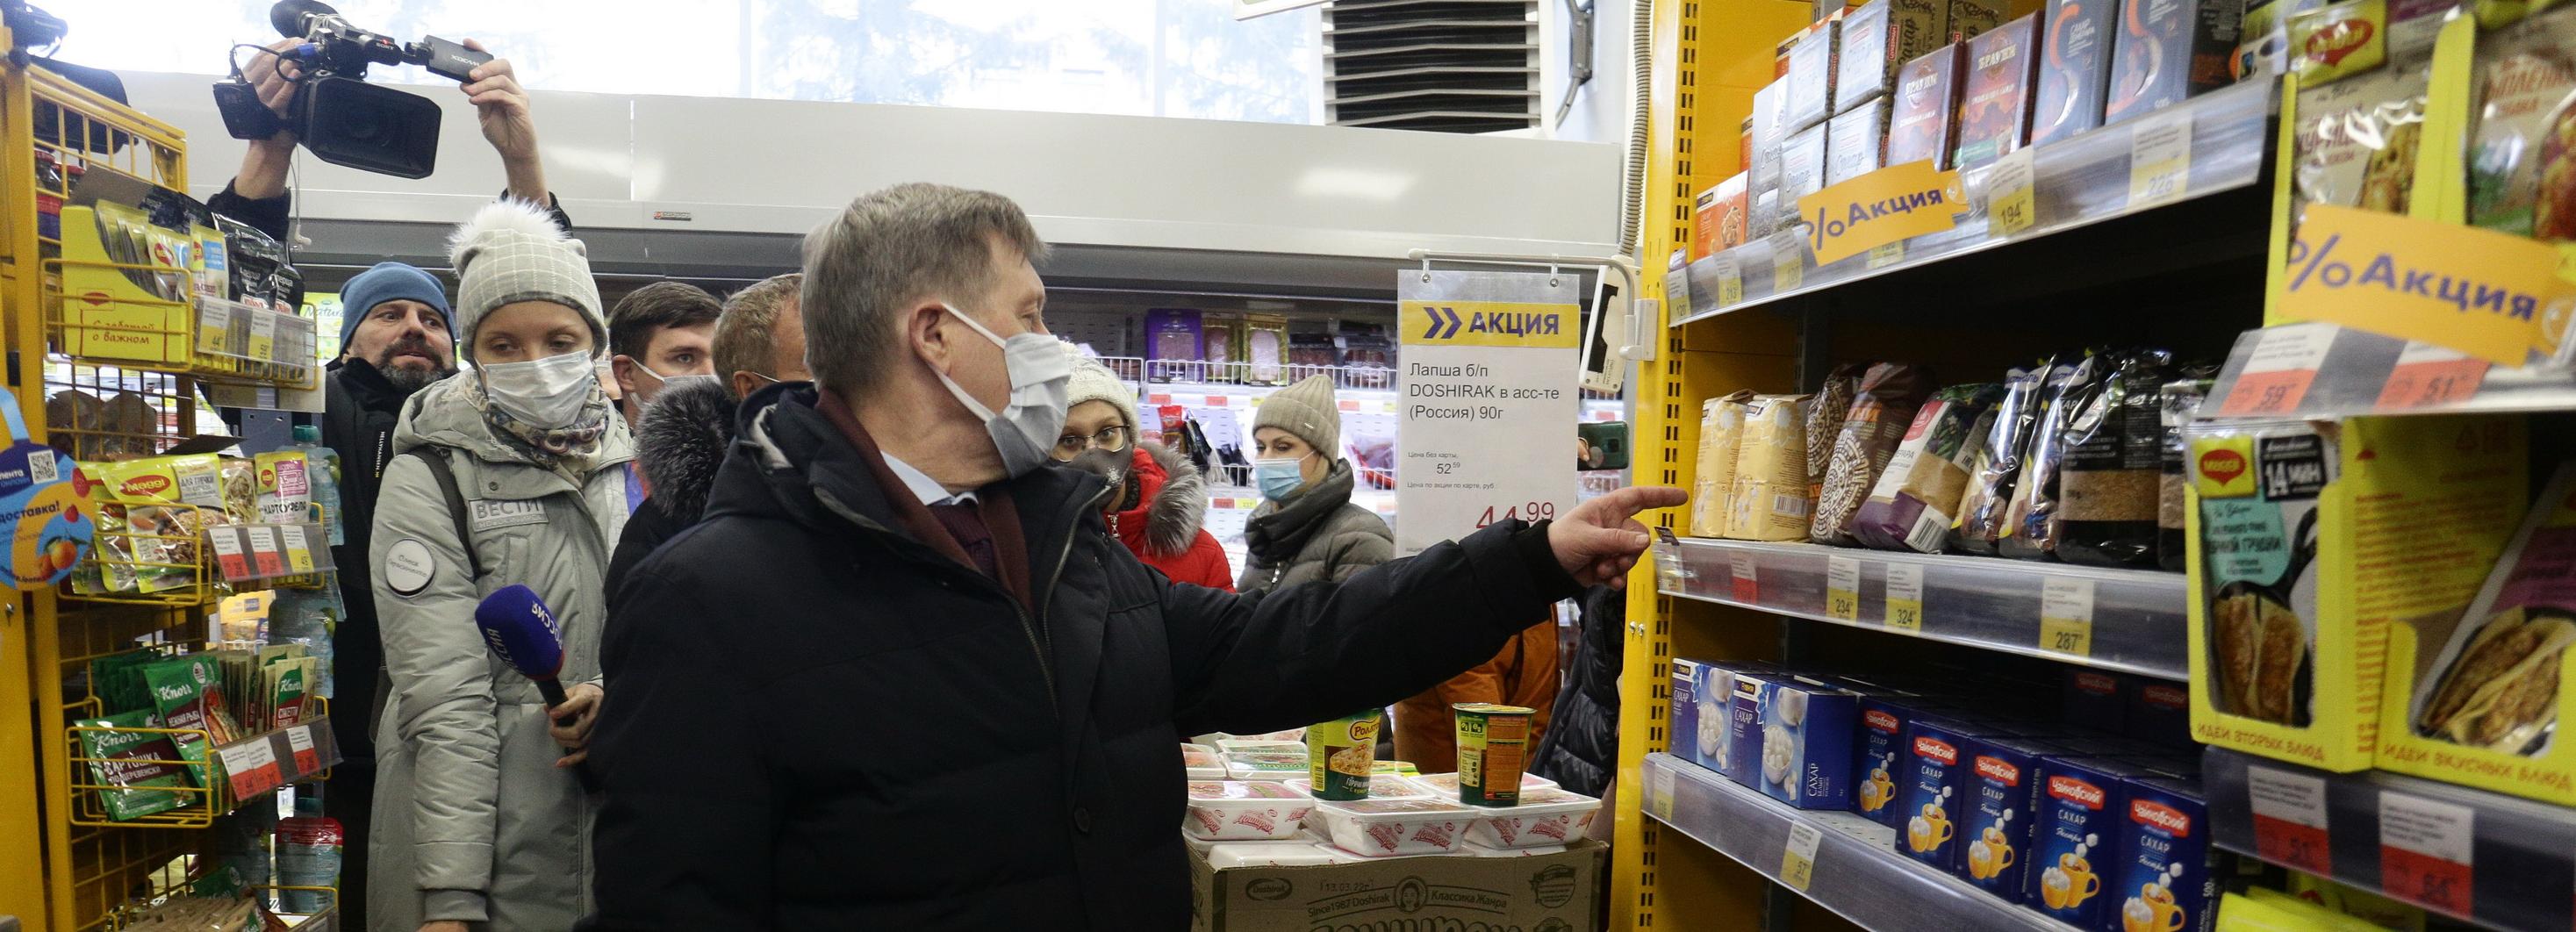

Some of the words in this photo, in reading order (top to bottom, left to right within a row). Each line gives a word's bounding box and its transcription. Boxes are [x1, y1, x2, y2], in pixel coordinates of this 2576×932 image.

[1848, 189, 1943, 227] Акция
[2358, 254, 2538, 321] Акция
[1468, 312, 1559, 337] АКЦИЯ
[1410, 362, 1461, 376] Лапша
[1466, 363, 1488, 376] б/п
[1410, 384, 1495, 398] DOSHIRAK
[1500, 388, 1508, 398] в
[1513, 388, 1560, 399] асс-те
[1410, 405, 1475, 421] (Россия)
[1480, 405, 1503, 419] 90г
[1437, 463, 1452, 474] 52
[2265, 462, 2290, 498] 14
[2288, 462, 2321, 484] МИН
[476, 499, 540, 520] ВЕСТИ
[1835, 599, 1850, 613] 234
[1897, 608, 1912, 625] 324
[2056, 631, 2079, 651] 287
[159, 684, 192, 700] Knorr
[97, 732, 141, 747] Knorr
[2198, 723, 2231, 741] ИДЕИ
[2234, 728, 2282, 751] ВТОРЫХ
[2285, 741, 2325, 762] БЛЮД
[1921, 765, 1943, 779] САХАР
[2384, 742, 2431, 764] ИДЕИ
[2434, 751, 2514, 779] ВКУСНЫХ
[2517, 762, 2573, 793] БЛЮД
[1808, 763, 1819, 797] САХАР
[1982, 786, 2005, 801] САХАР
[2057, 809, 2086, 826] САХАР
[2141, 835, 2170, 854] САХАР
[1353, 893, 1390, 907] Doshirak
